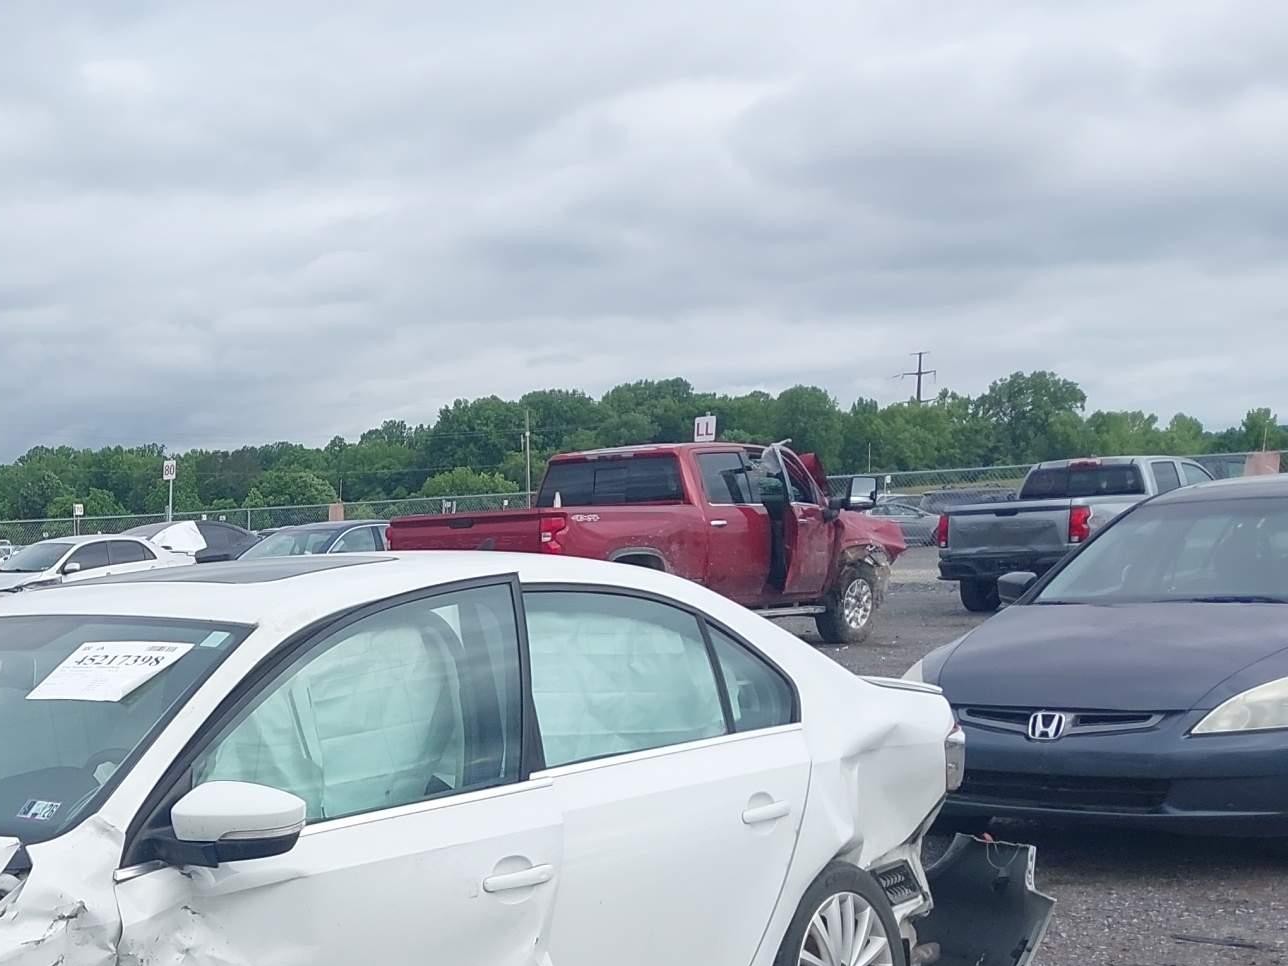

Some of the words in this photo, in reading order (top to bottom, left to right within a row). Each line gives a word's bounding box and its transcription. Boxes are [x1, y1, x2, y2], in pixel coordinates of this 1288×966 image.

[696, 421, 713, 437] LL
[164, 464, 175, 476] 80
[74, 655, 165, 667] 45217398
